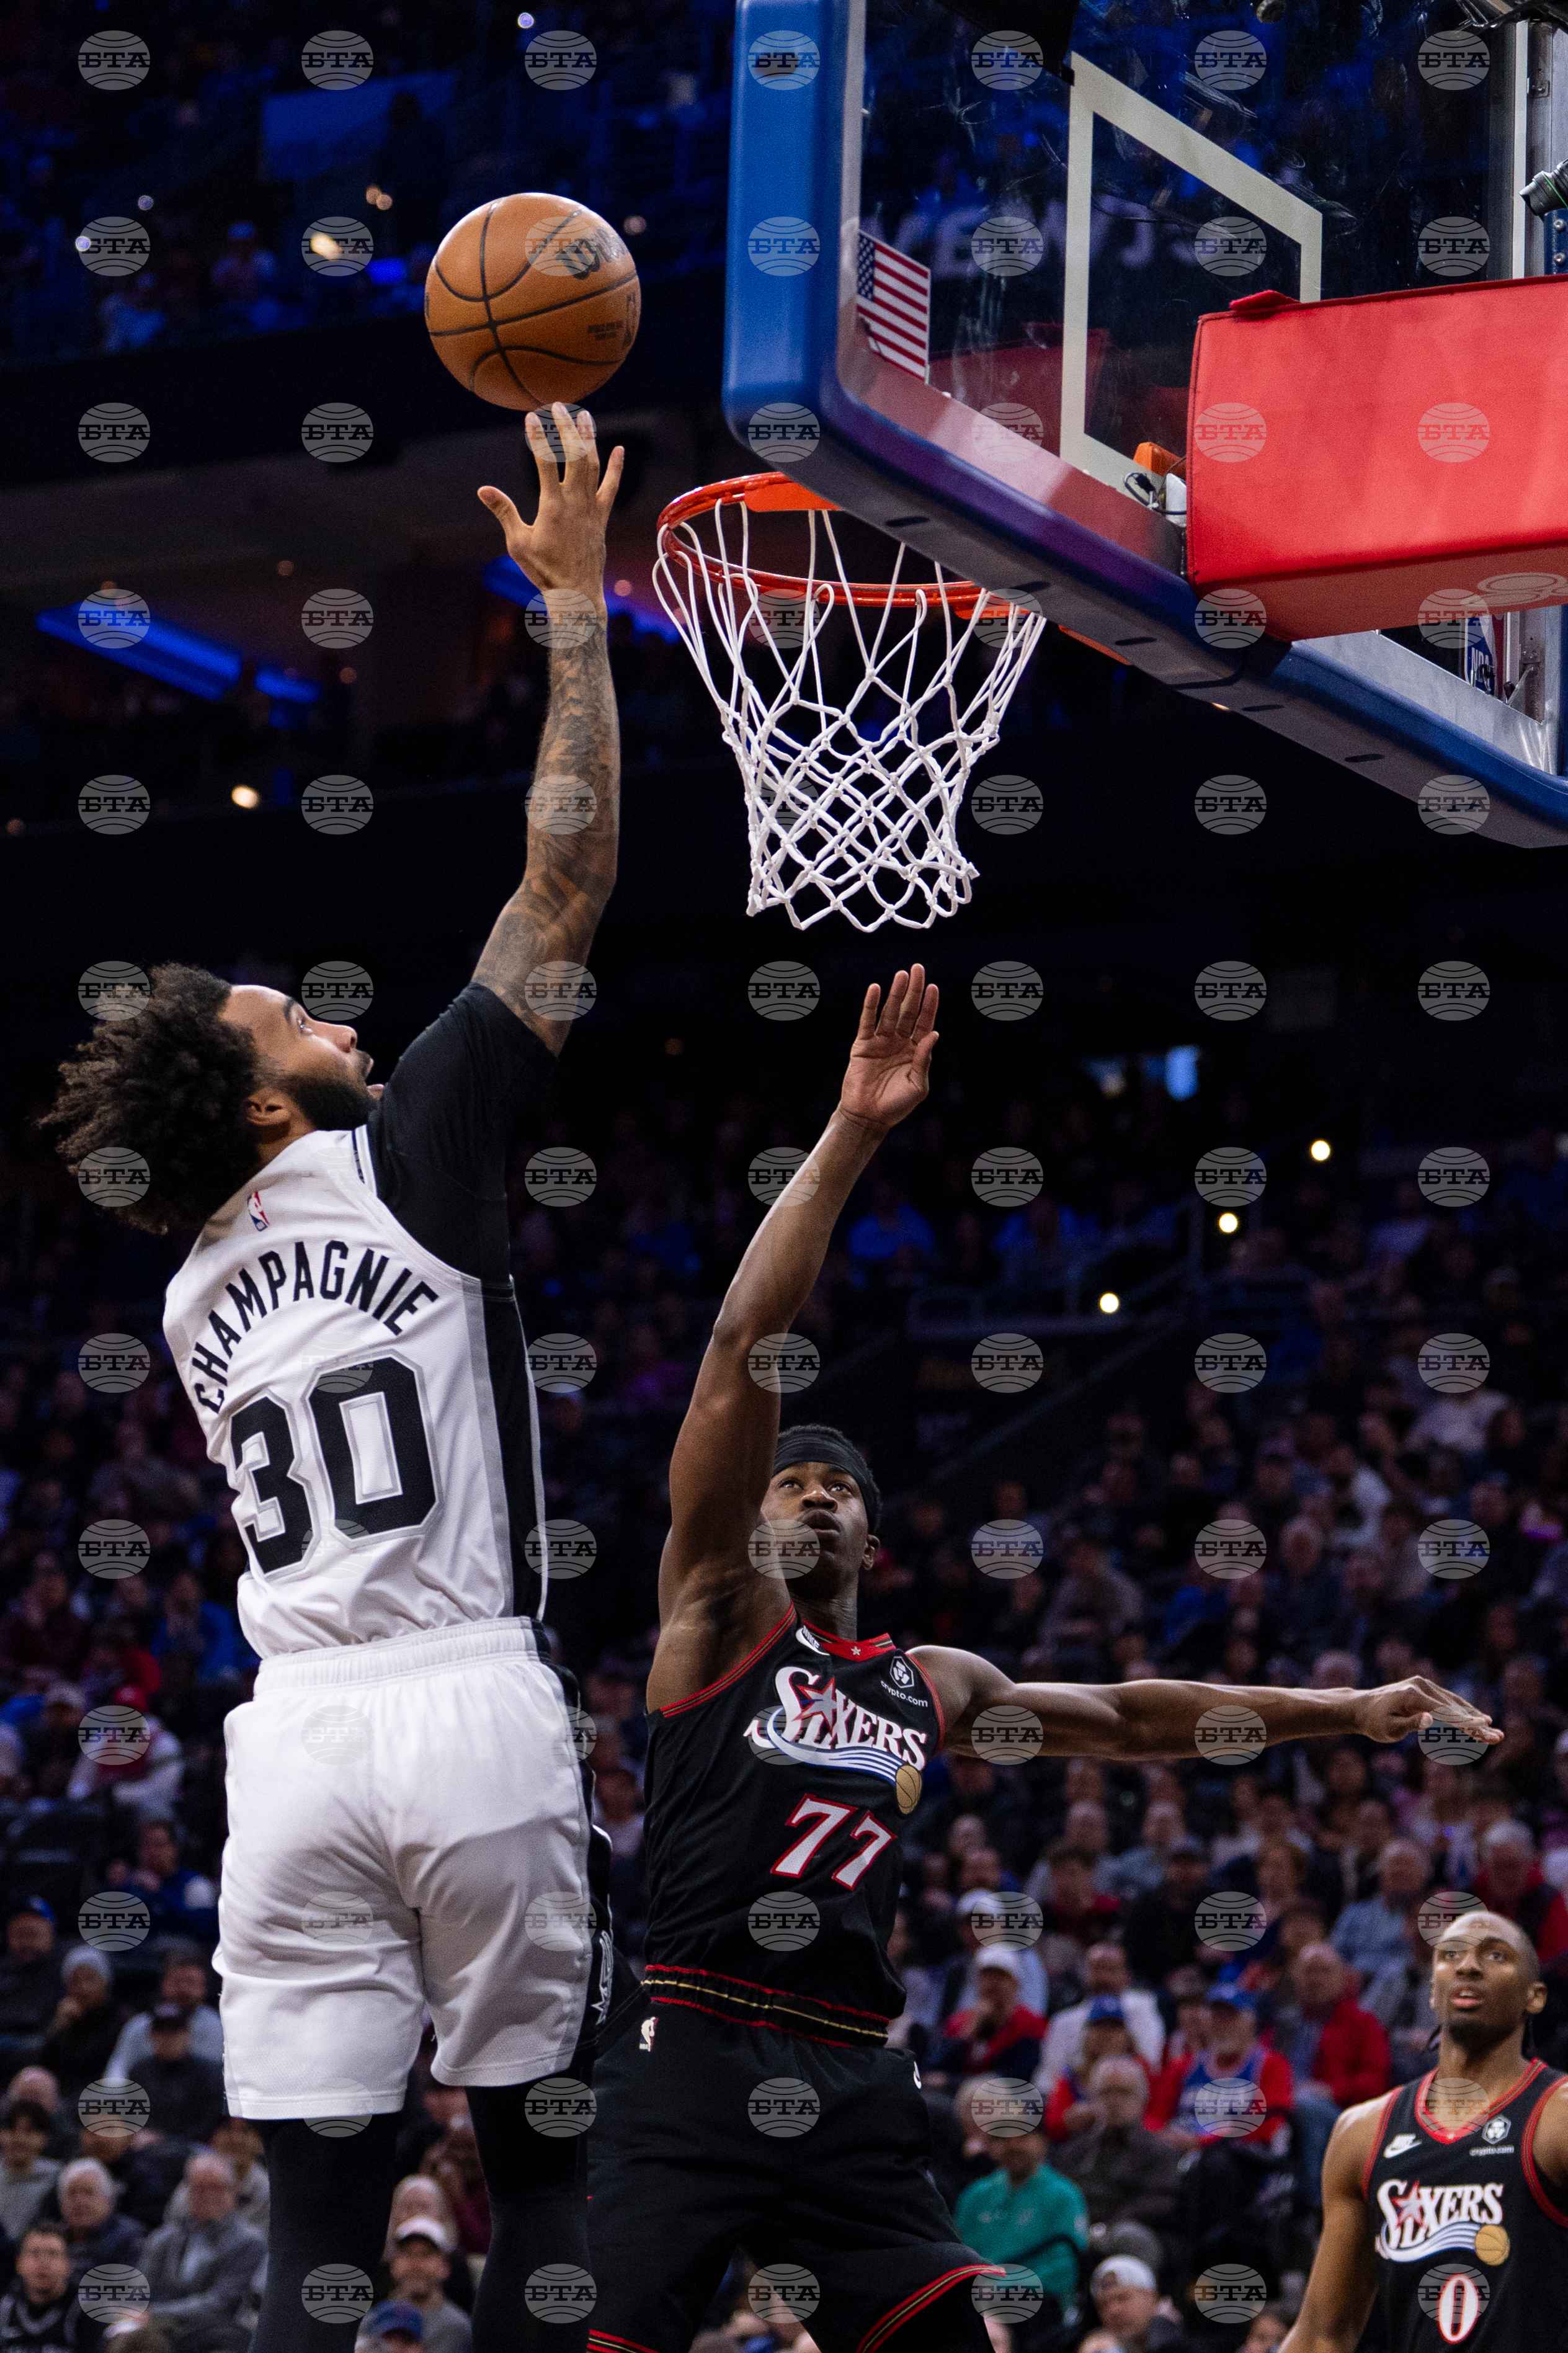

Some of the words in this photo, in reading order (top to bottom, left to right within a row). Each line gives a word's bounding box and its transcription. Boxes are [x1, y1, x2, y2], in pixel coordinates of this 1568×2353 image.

[191, 1241, 439, 1414] CHAMPAGNIE
[229, 1348, 442, 1578] 30
[881, 1680, 929, 1708] crypto.com
[770, 1793, 898, 1891] 77
[1437, 2273, 1481, 2345] 0
